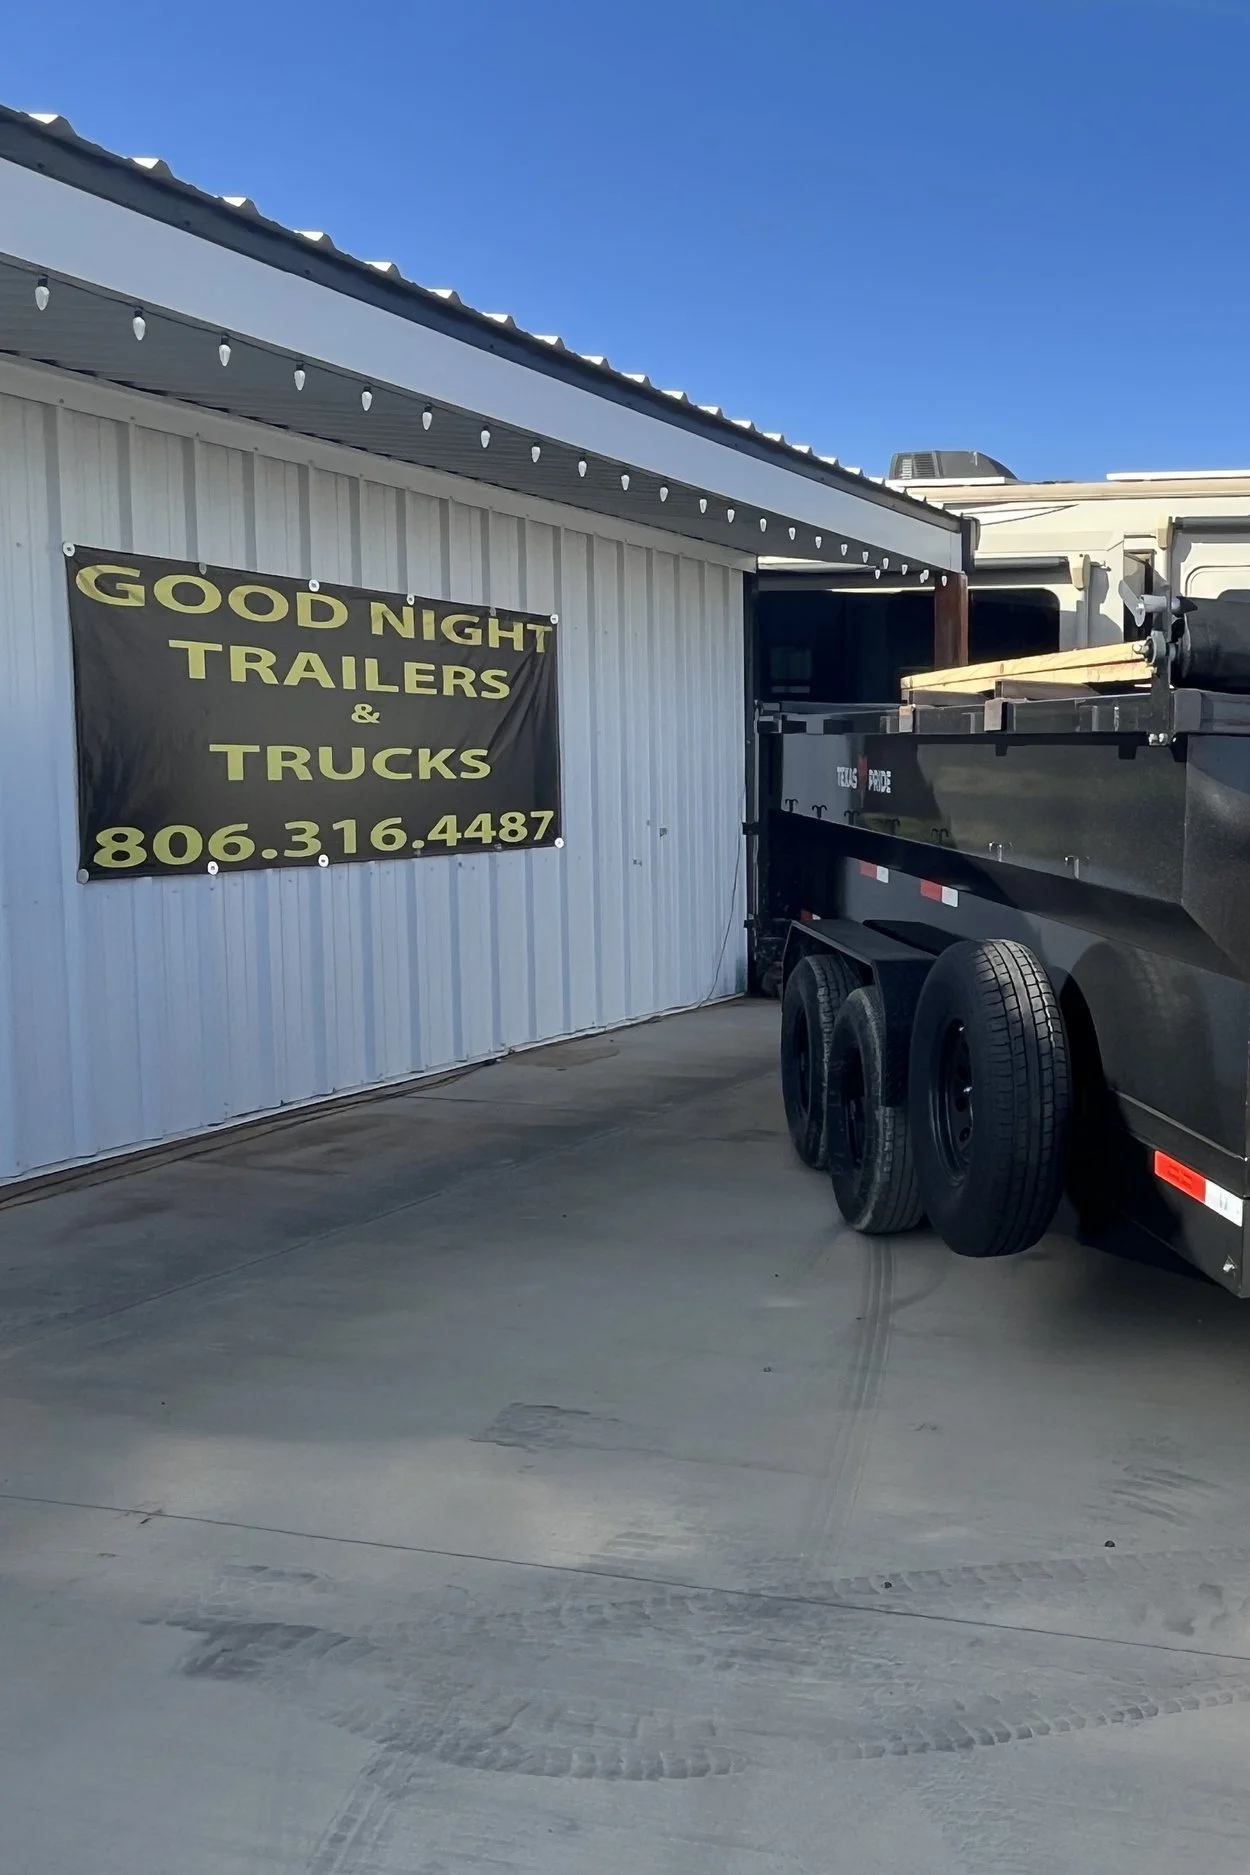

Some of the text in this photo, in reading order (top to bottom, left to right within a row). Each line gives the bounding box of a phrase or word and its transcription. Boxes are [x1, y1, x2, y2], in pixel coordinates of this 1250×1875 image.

[75, 564, 552, 653] GOOD NIGHT
[168, 639, 511, 700] TRAILERS
[351, 703, 381, 724] &
[209, 744, 492, 781] TRUCKS
[836, 766, 891, 794] TEXAS PRIDE
[93, 810, 554, 868] 806.316.4487
